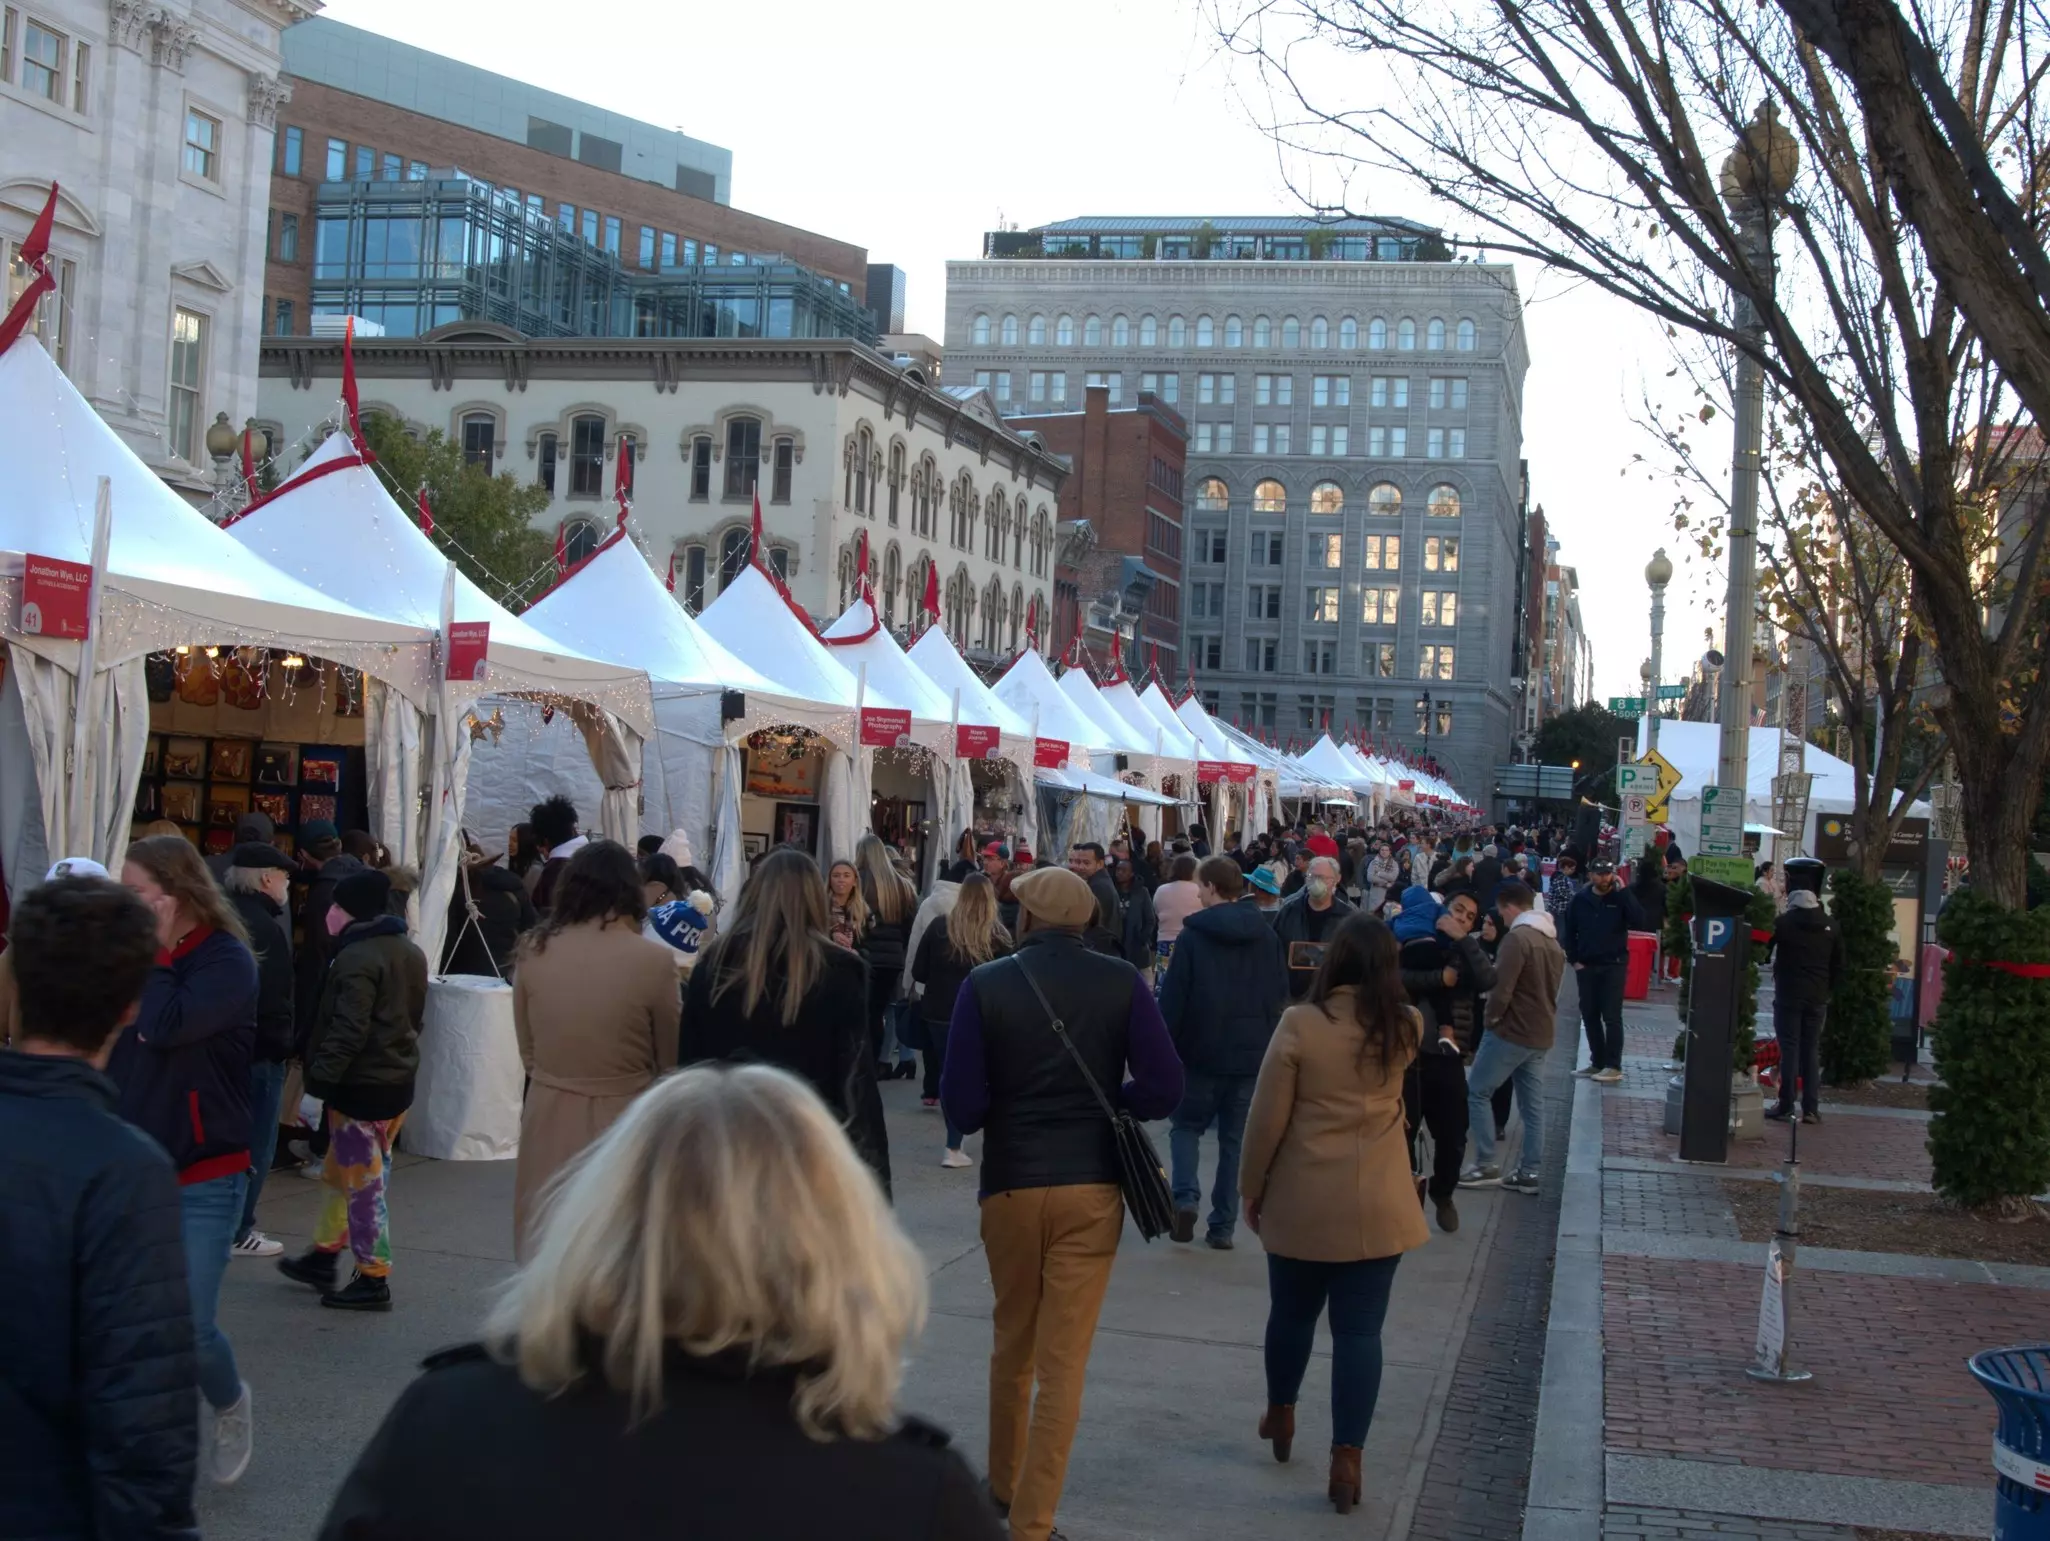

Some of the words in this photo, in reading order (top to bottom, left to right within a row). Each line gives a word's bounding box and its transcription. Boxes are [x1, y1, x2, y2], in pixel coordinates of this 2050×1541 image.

[75, 572, 88, 583] LLC
[25, 612, 37, 627] 41
[1617, 699, 1626, 709] 8
[1621, 769, 1636, 789] P
[1707, 920, 1725, 945] P
